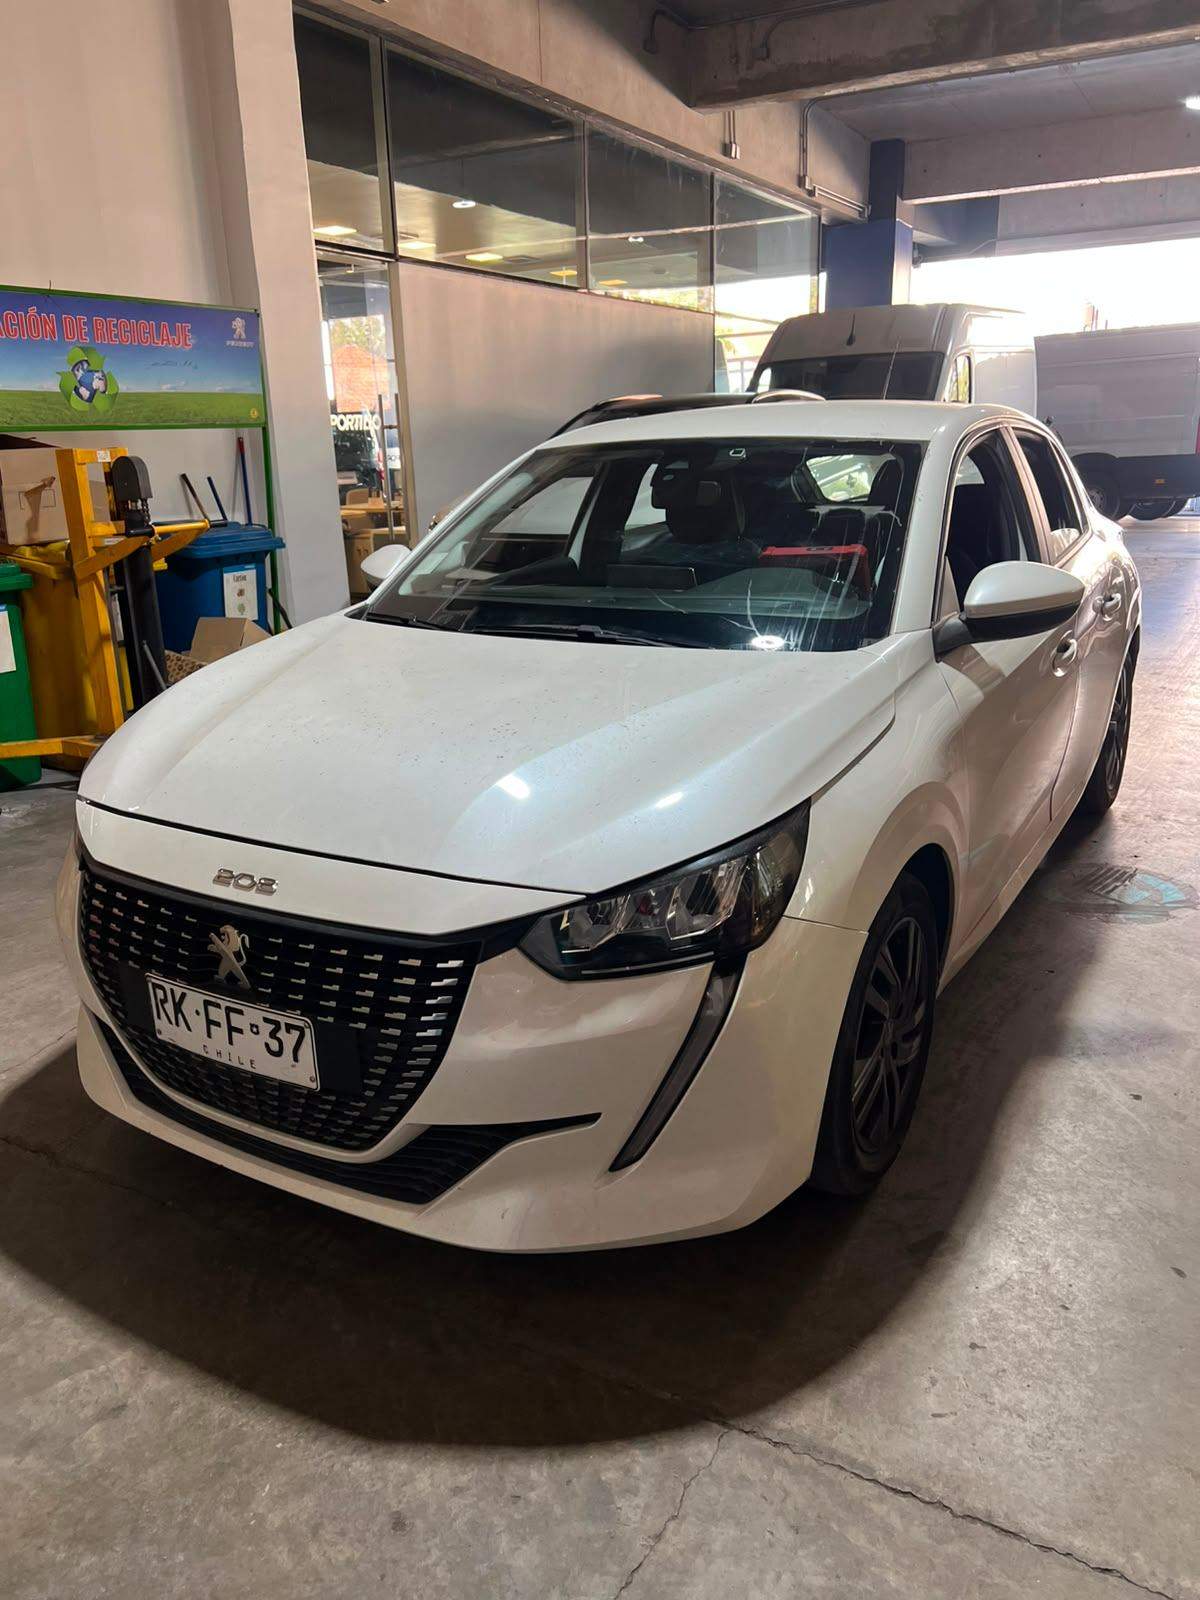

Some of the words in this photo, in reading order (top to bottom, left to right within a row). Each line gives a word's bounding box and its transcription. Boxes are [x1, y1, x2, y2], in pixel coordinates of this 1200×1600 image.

[62, 314, 89, 343] DE
[93, 316, 192, 349] RECICLAJE
[213, 868, 276, 896] 208
[203, 1044, 256, 1070] CHILE
